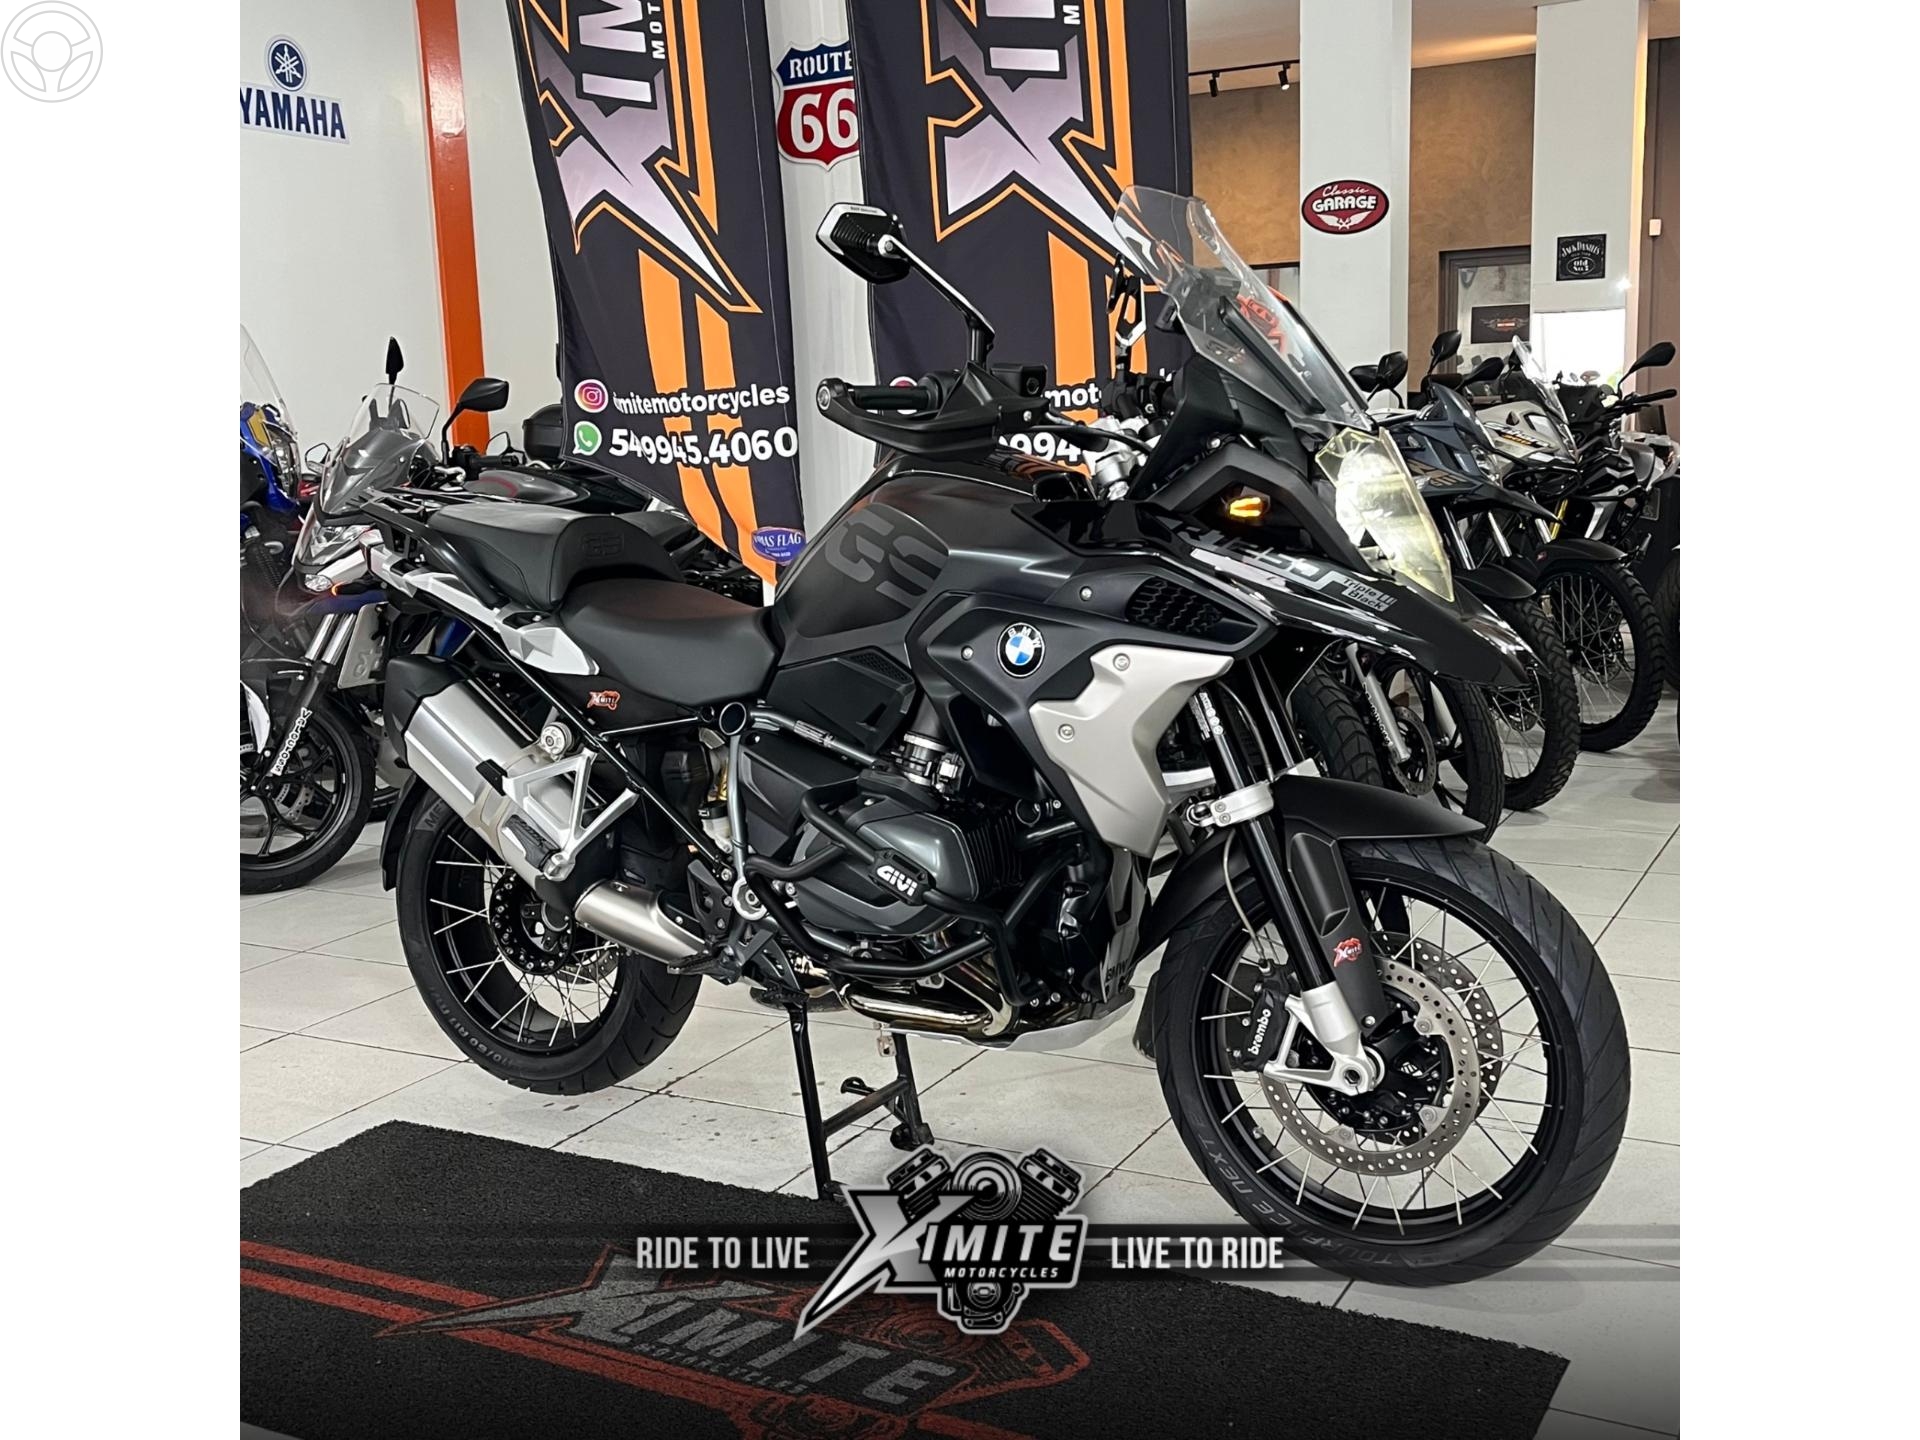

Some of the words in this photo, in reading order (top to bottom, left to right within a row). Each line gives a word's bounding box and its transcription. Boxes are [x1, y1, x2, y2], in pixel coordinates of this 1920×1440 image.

[789, 50, 853, 79] ROUTE
[239, 87, 346, 139] YAMAHA
[790, 87, 859, 153] 66
[1312, 195, 1377, 212] GARAGE
[1322, 184, 1370, 198] Classic
[777, 531, 801, 547] FLAG
[825, 509, 950, 611] GS
[1343, 578, 1377, 597] Triple
[1348, 590, 1383, 609] Black
[1007, 626, 1042, 648] BMW
[1247, 1008, 1271, 1056] brembo
[1197, 1134, 1253, 1194] NEXT
